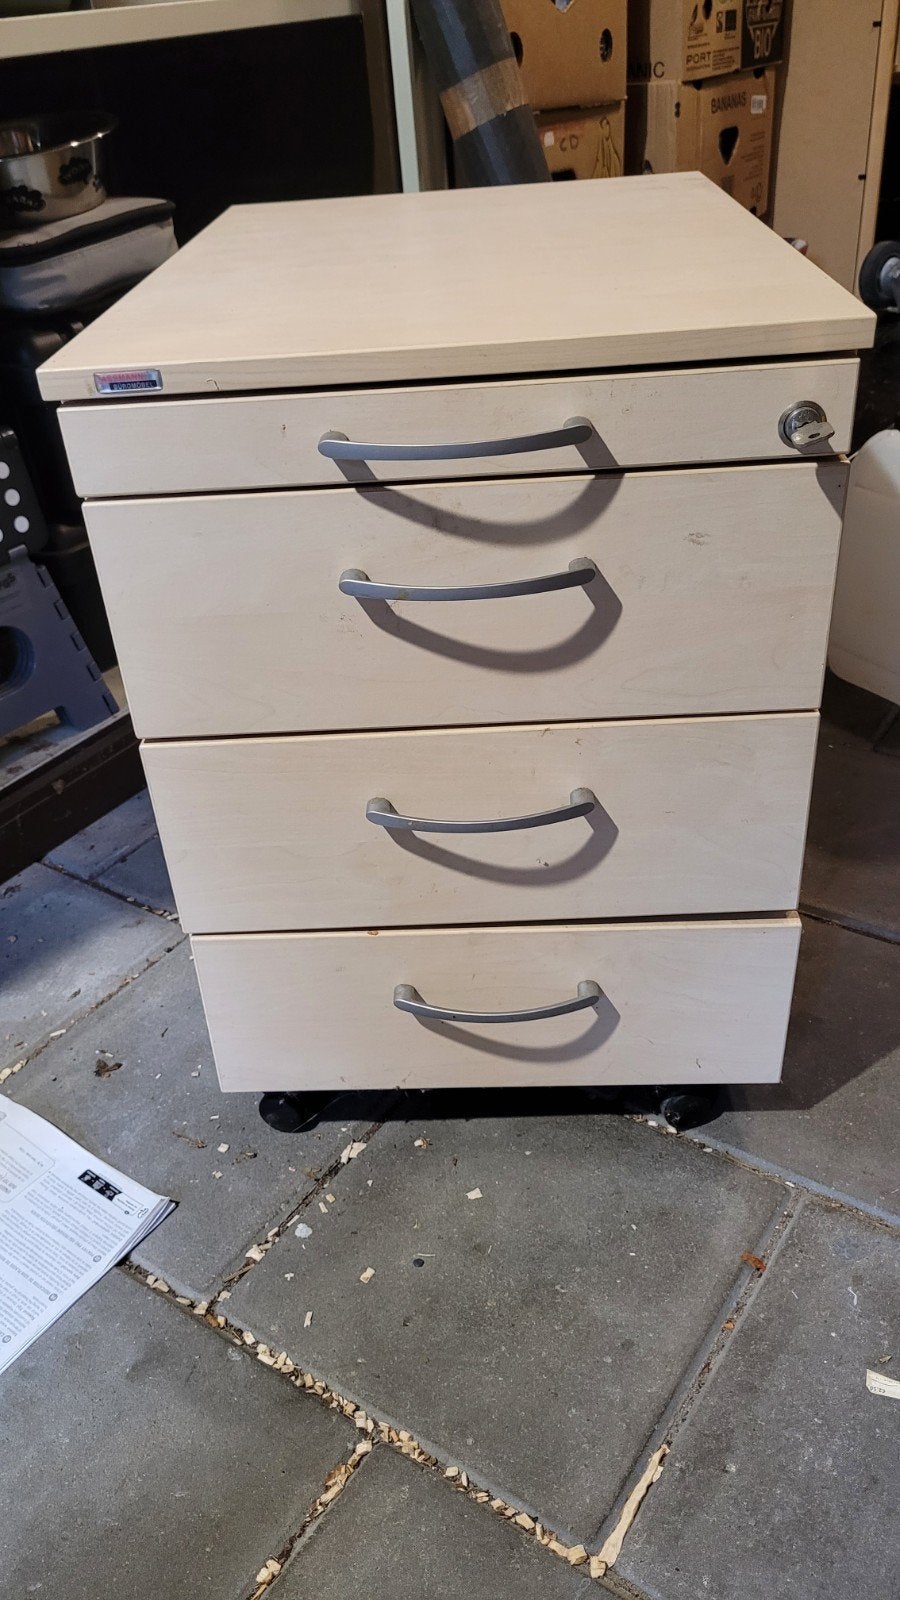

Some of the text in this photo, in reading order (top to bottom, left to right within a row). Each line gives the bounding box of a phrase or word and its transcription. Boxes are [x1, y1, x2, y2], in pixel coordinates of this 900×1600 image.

[753, 27, 773, 59] BIO
[686, 51, 712, 65] PORT
[711, 91, 747, 114] BANANAS
